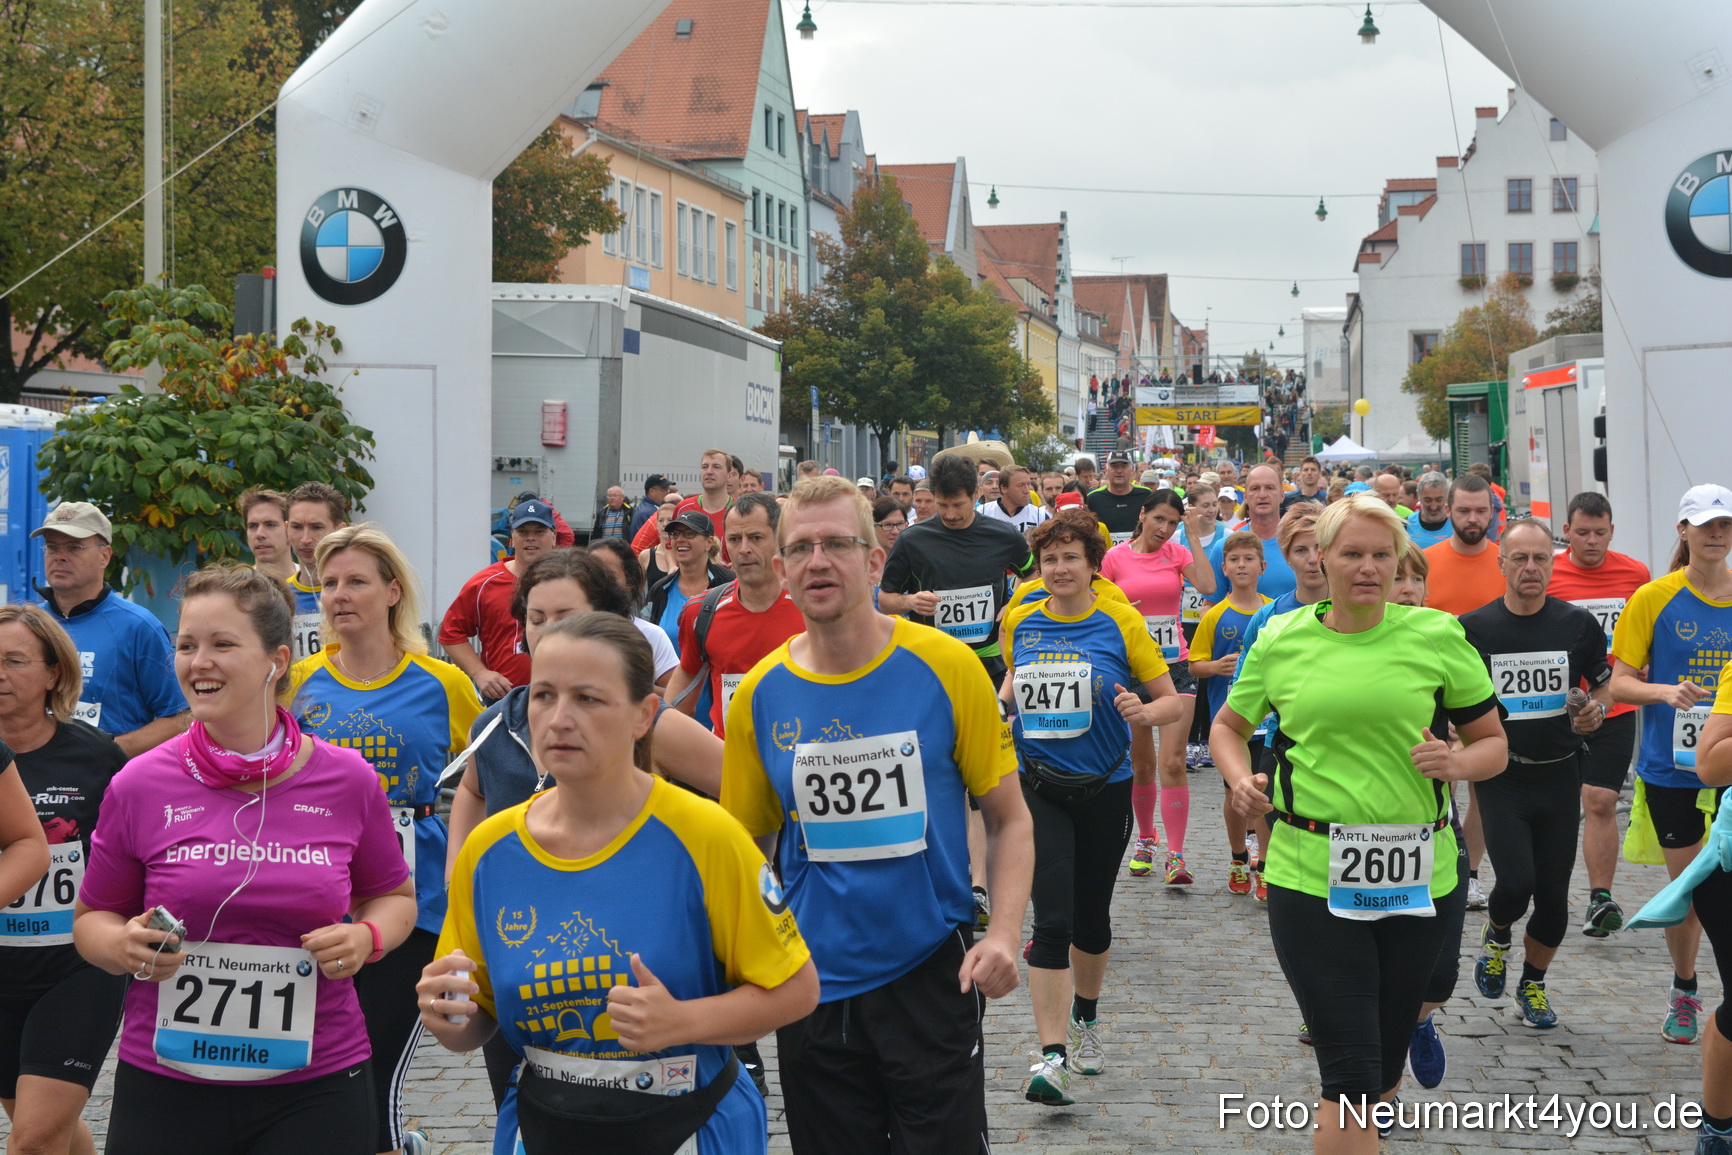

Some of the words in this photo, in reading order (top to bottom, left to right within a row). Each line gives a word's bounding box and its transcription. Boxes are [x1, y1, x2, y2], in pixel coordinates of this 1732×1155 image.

[1675, 153, 1732, 197] BM
[307, 189, 399, 229] BMW
[745, 381, 774, 425] BOCK
[1176, 410, 1219, 421] START
[1190, 596, 1204, 609] 24
[940, 600, 988, 624] 2617
[1597, 611, 1620, 631] 78
[950, 626, 983, 636] Matthias
[1154, 627, 1173, 646] 11
[1493, 660, 1518, 668] PARTL
[1520, 658, 1555, 666] Neumarkt
[1015, 672, 1037, 680] PARTL
[1039, 670, 1076, 679] Neumarkt
[1500, 668, 1562, 694] 2805
[1021, 681, 1080, 710] 2471
[1521, 699, 1543, 710] Paul
[1038, 717, 1069, 728] Marion
[778, 731, 795, 740] Jahre
[795, 755, 830, 767] PARTL
[833, 747, 896, 766] Neumarkt
[805, 763, 908, 816] 3321
[174, 814, 192, 823] Run
[294, 804, 325, 815] CRAFT
[1332, 833, 1368, 841] PARTL
[1371, 832, 1416, 842] Neumarkt
[165, 839, 332, 866] Energiebündel
[1340, 846, 1421, 884] 2601
[1353, 893, 1409, 907] Susanne
[512, 911, 522, 919] 15
[6, 918, 50, 935] Helga
[504, 923, 528, 931] Jahre
[181, 954, 214, 969] RTL
[219, 958, 290, 974] Neumarkt
[173, 974, 295, 1031] 2711
[526, 996, 602, 1016] 21.September
[162, 1018, 168, 1027] D
[193, 1040, 269, 1064] Henrike
[561, 1070, 629, 1088] Neumarkt
